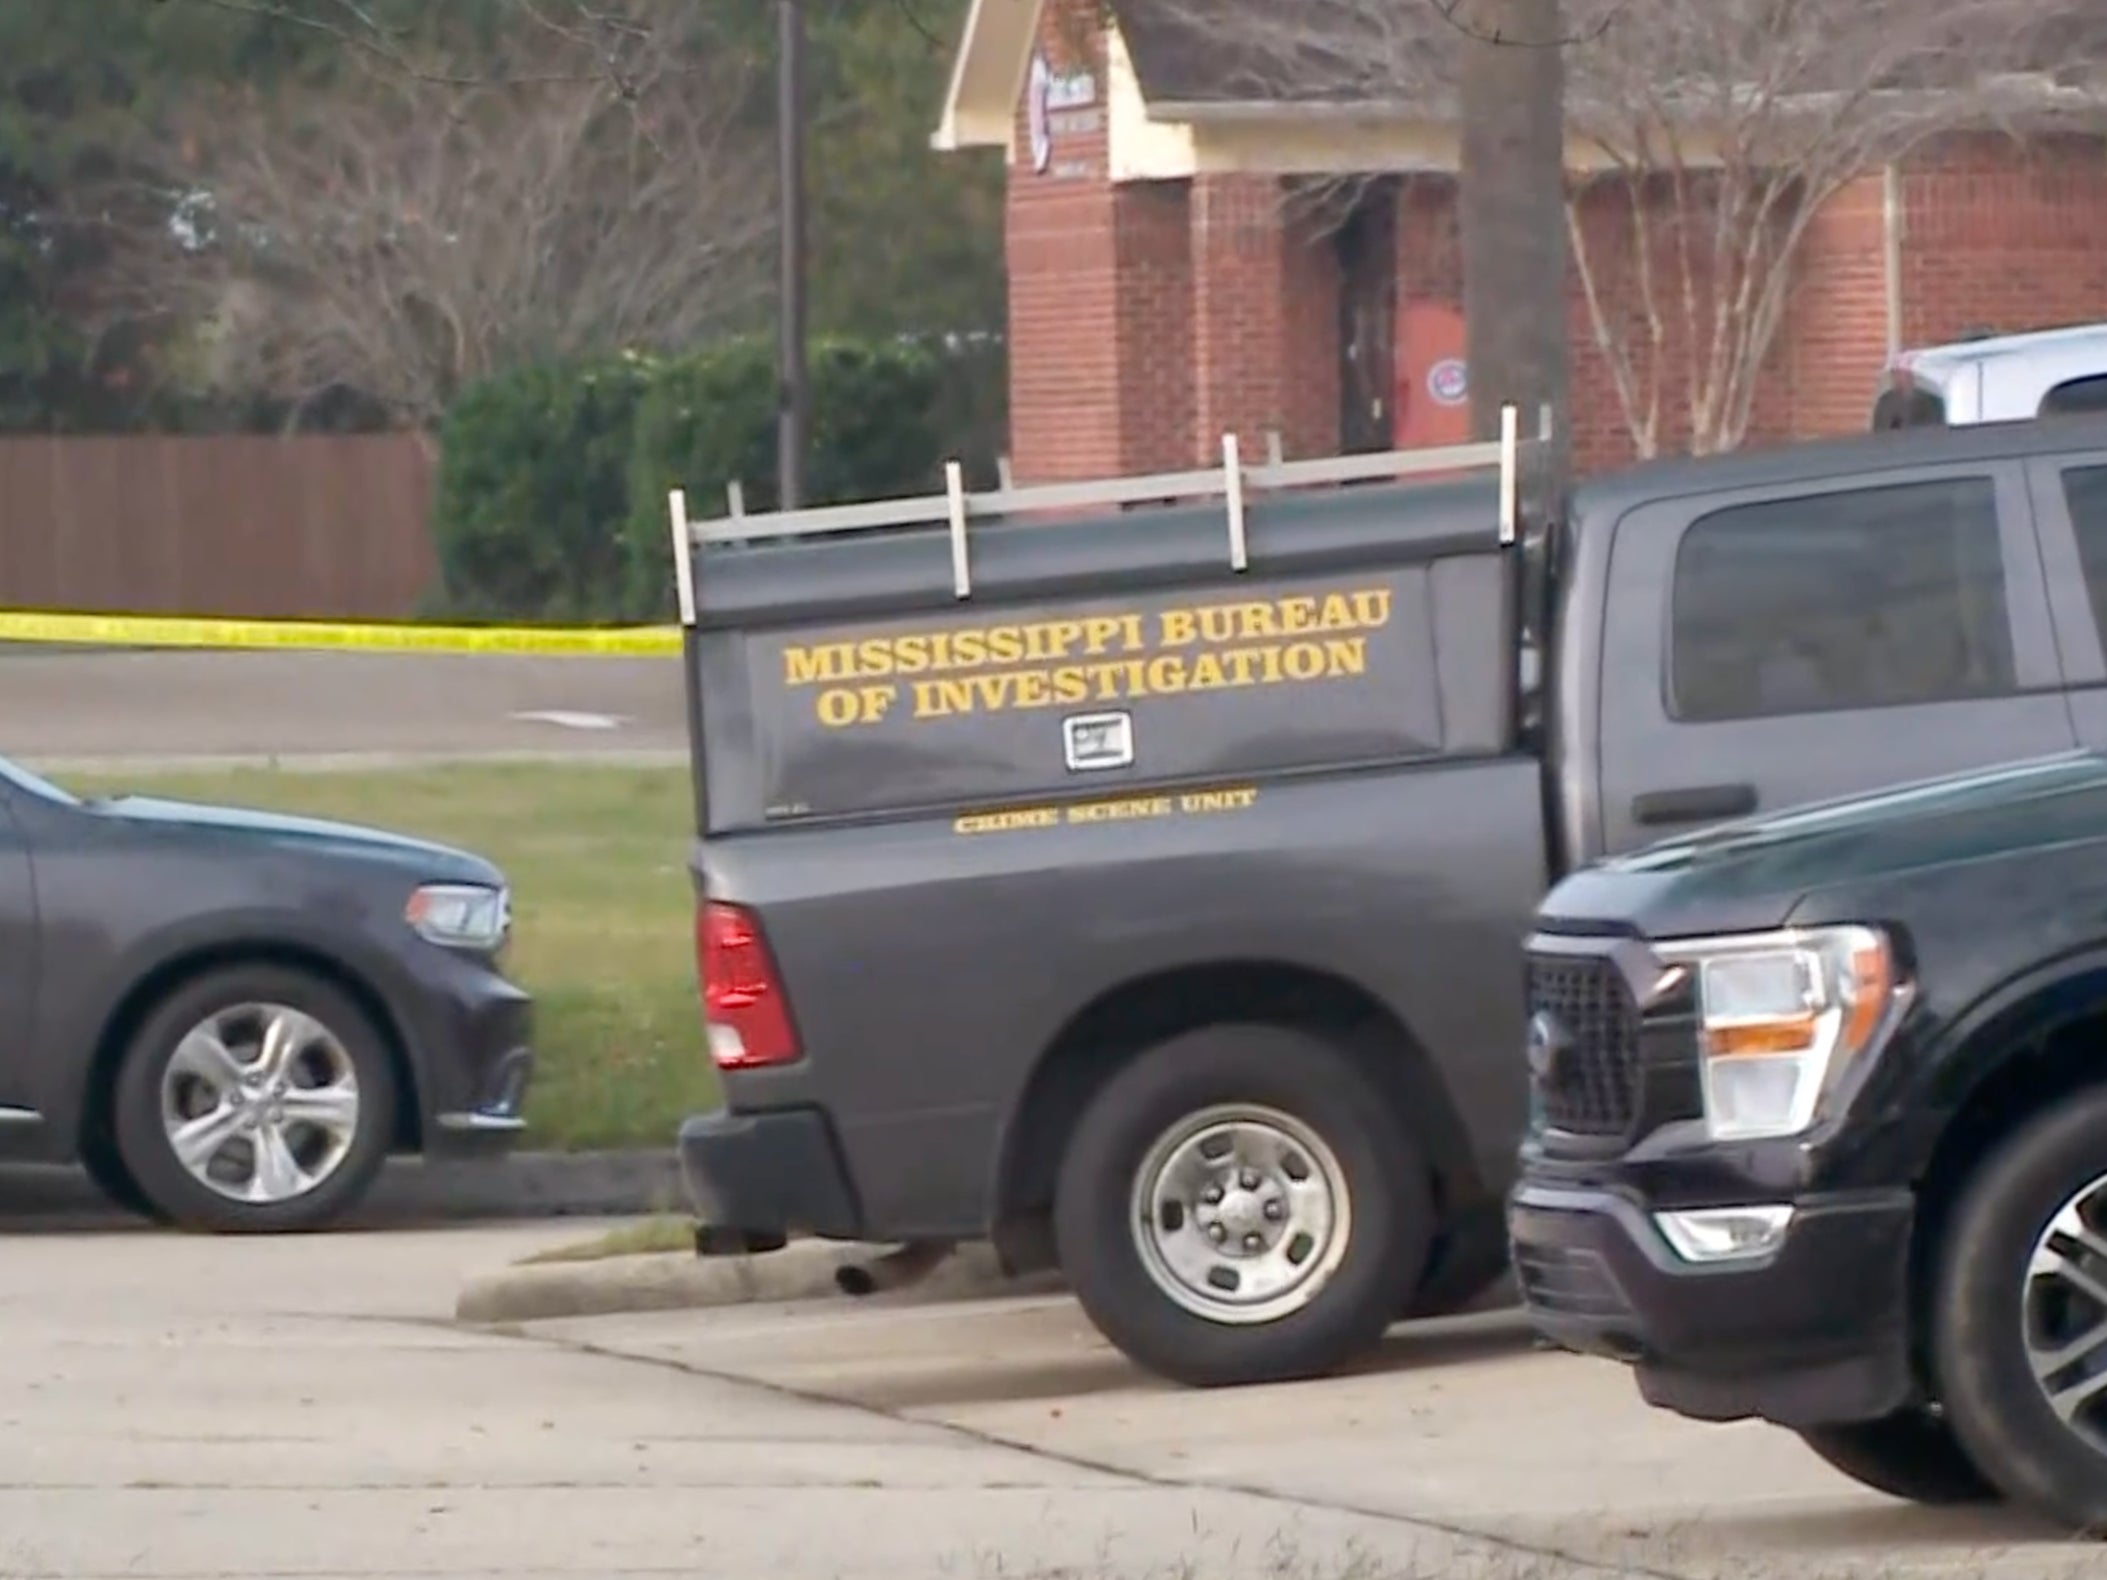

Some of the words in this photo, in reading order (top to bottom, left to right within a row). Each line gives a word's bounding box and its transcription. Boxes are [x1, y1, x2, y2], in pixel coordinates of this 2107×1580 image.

[783, 613, 1143, 686] MISSISSIPPI
[1159, 589, 1392, 647] BUREAU
[817, 685, 897, 727] OF
[912, 637, 1366, 718] INVESTIGATION
[954, 808, 1059, 834] CRIME
[1066, 797, 1172, 824] SCENE
[1181, 788, 1257, 813] UNIT
